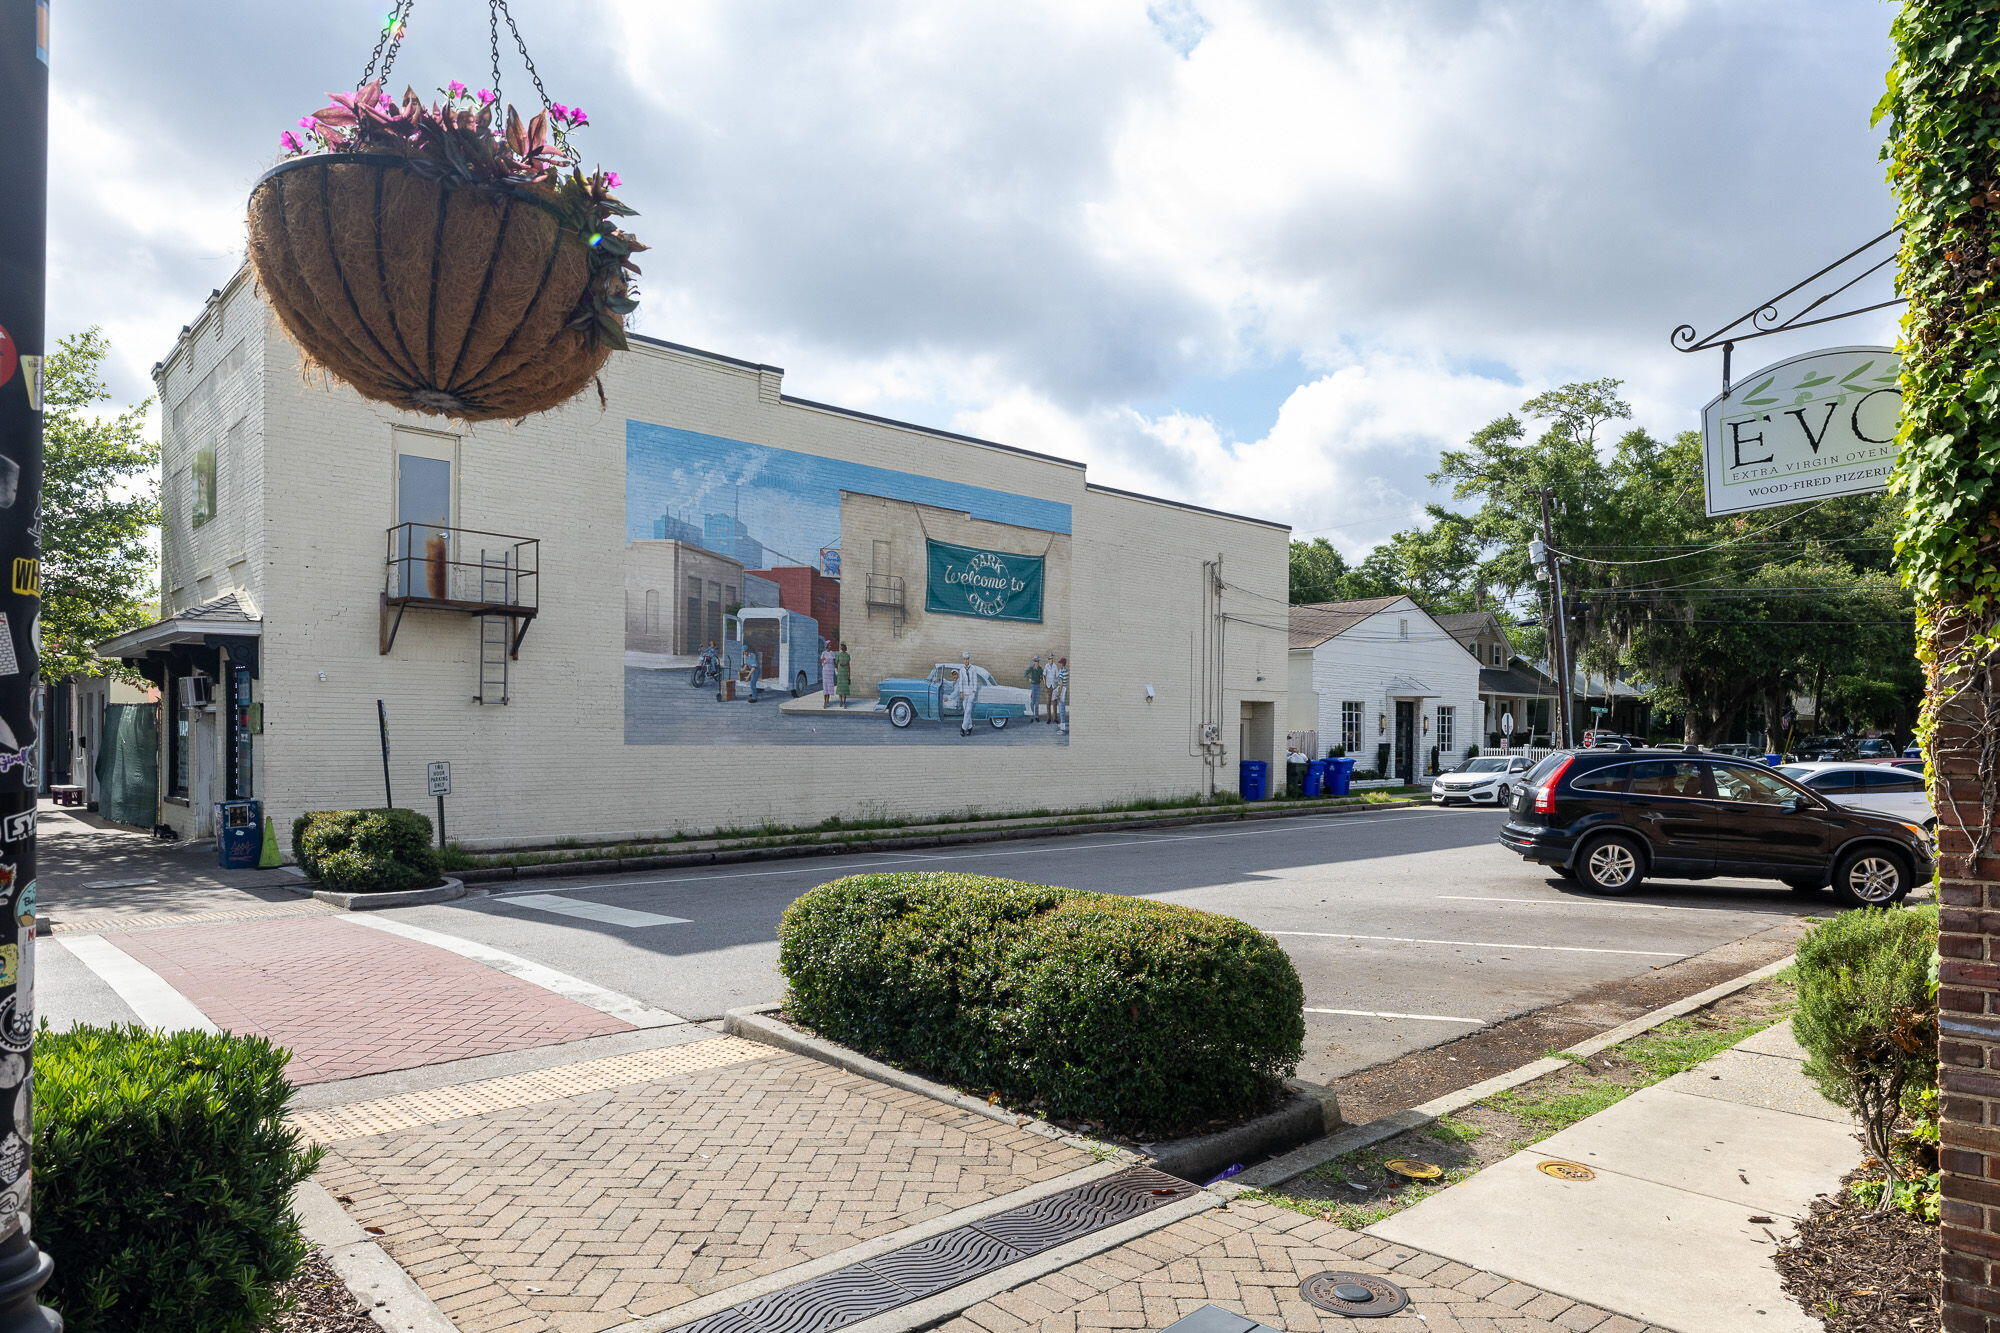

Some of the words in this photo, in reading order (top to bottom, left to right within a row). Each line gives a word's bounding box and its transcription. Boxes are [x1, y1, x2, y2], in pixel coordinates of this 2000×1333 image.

[1728, 388, 1903, 471] EVO
[1732, 466, 1778, 481] EXTRA
[1786, 455, 1839, 471] VIRGIN
[1846, 447, 1889, 461] OVEN
[1749, 477, 1831, 496] WOOD-FIRED
[1835, 465, 1896, 482] PIZZERIA
[971, 554, 1004, 573] PARK
[945, 565, 1007, 589] Welcome
[1011, 577, 1026, 592] to
[969, 592, 1006, 614] CIRCLE
